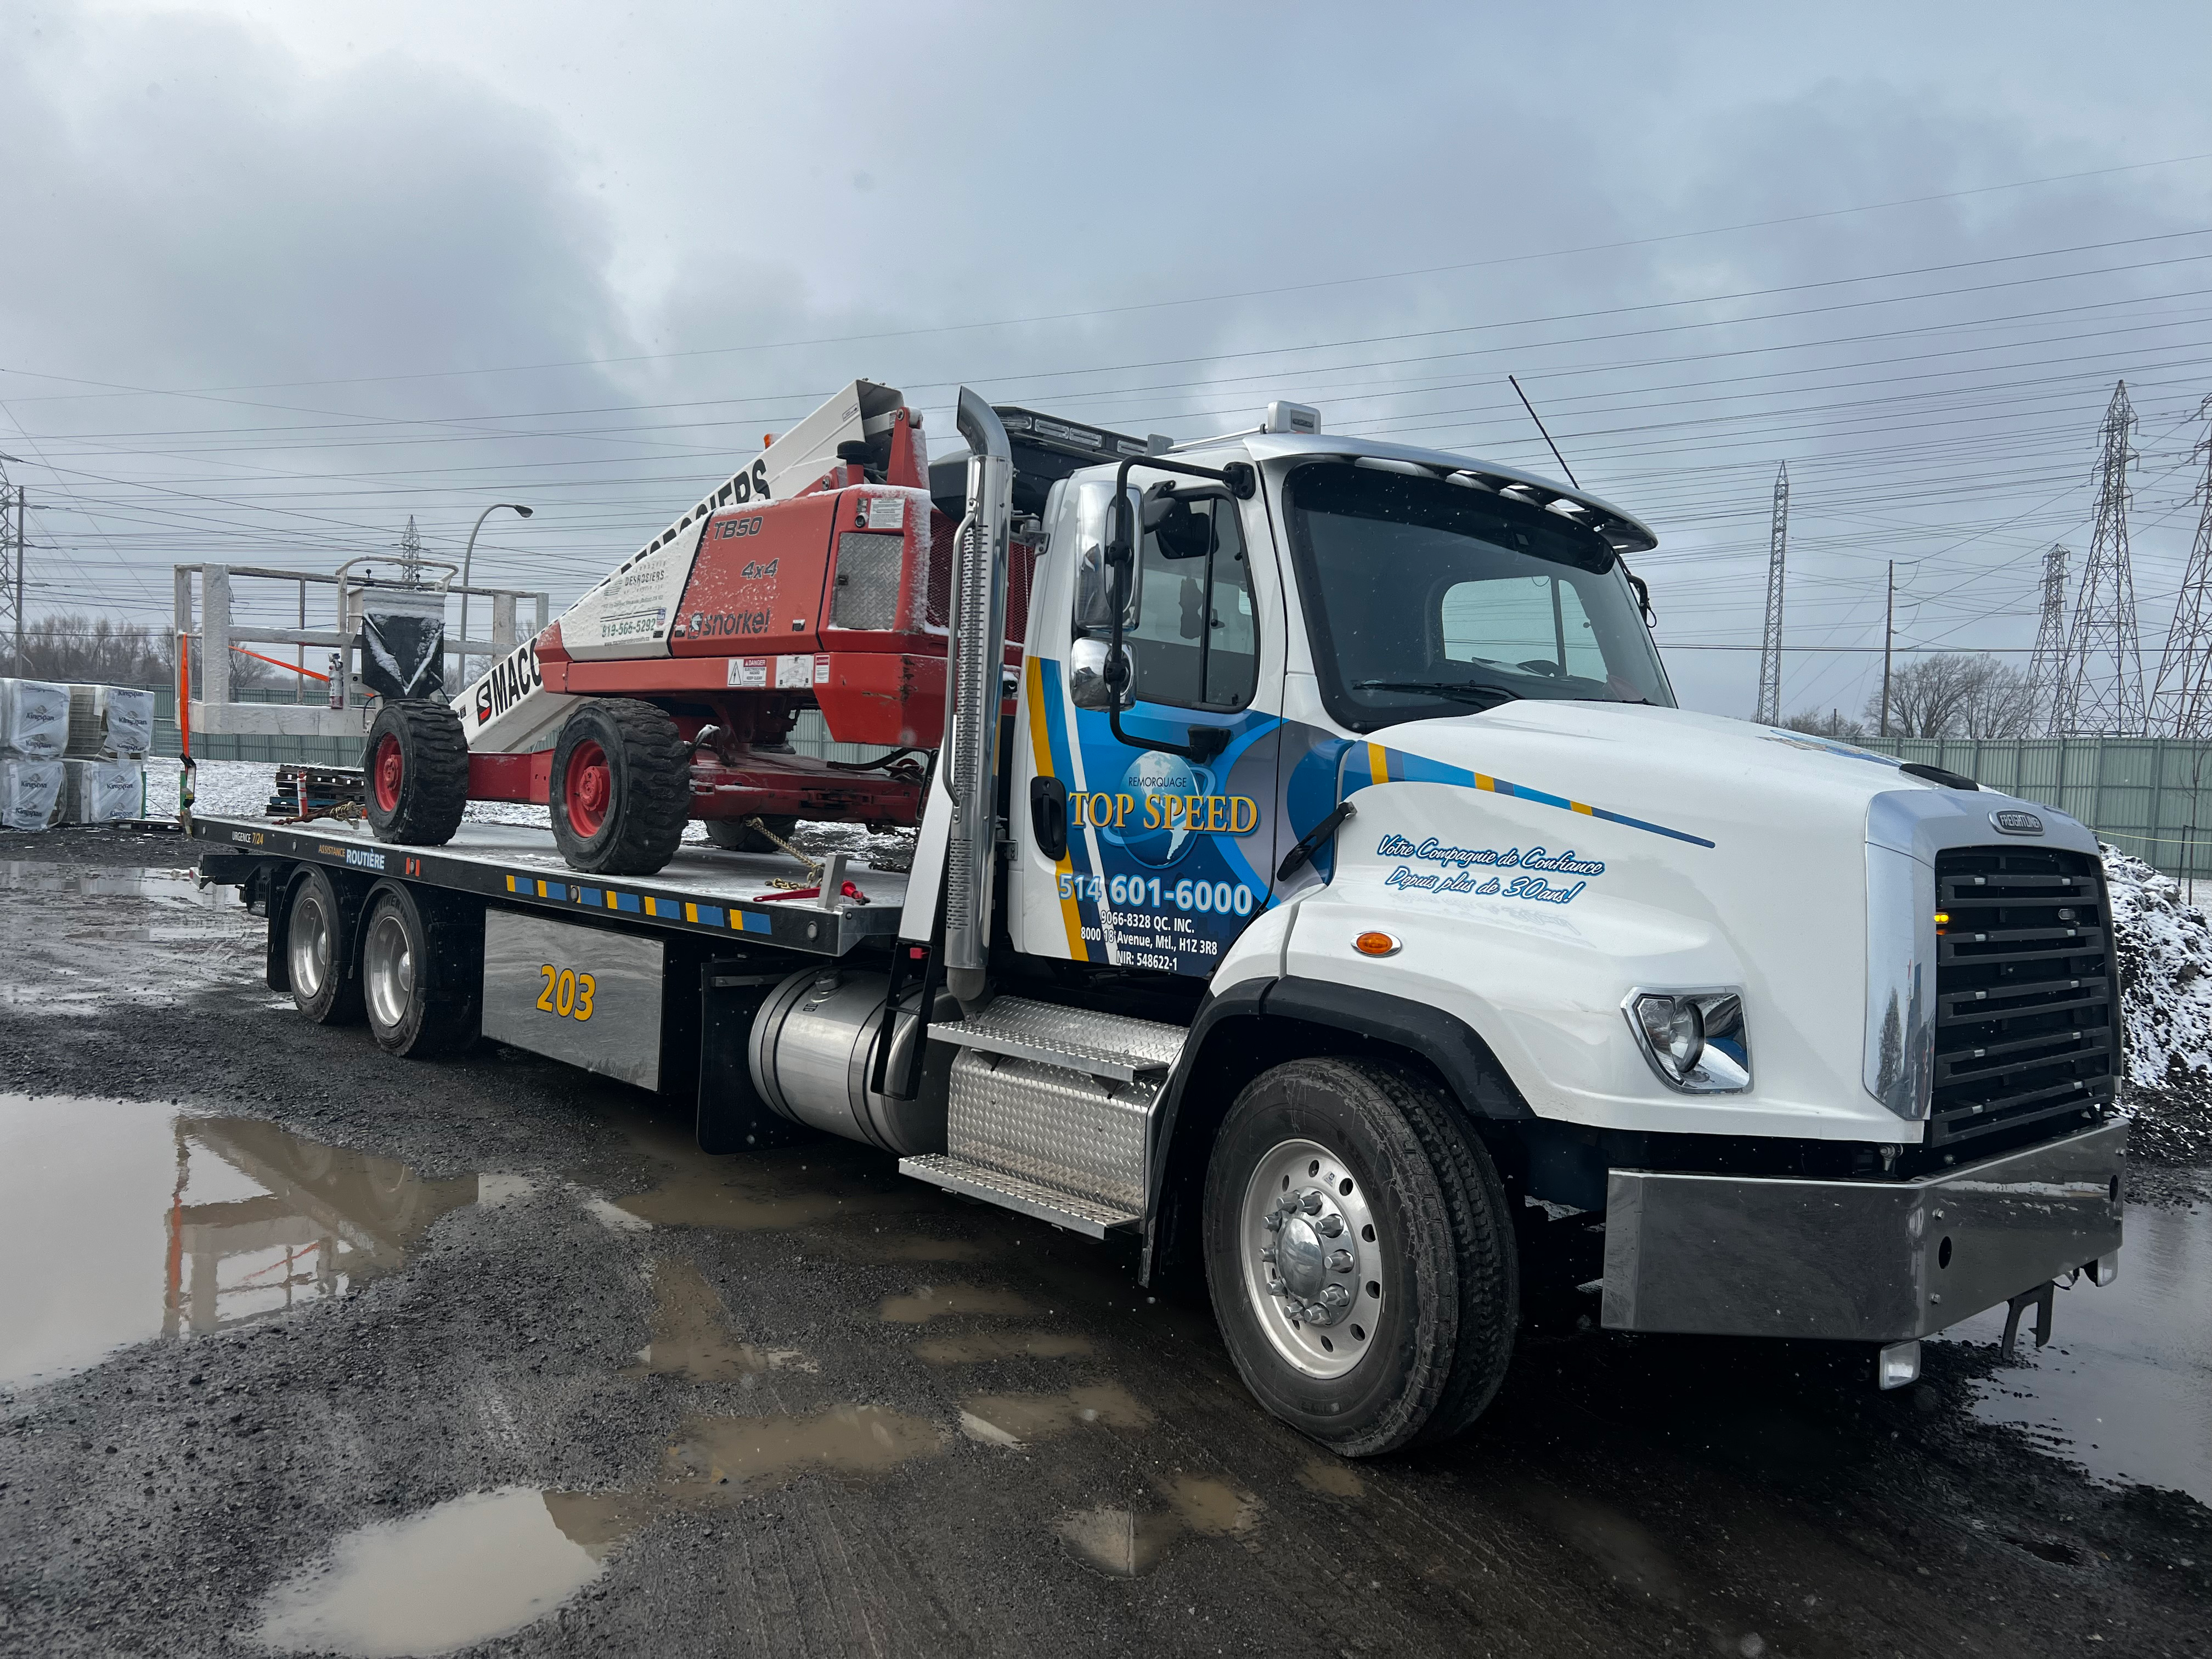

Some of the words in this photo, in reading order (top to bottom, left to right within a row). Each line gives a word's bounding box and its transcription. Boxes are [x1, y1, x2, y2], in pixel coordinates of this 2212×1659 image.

[714, 516, 763, 540] TB50
[624, 570, 664, 586] DESROSIERS
[741, 558, 780, 580] 4x4
[703, 608, 771, 636] snorkel
[118, 690, 144, 698] Kingspan
[26, 712, 54, 722] Kingspan
[1128, 776, 1187, 788] REMORQUAGE
[1069, 791, 1135, 828] TOP
[1143, 793, 1259, 833] SPEED
[1999, 814, 2041, 828] FREIGHTLINER
[232, 831, 251, 844] URGENCE
[251, 831, 264, 845] 7/24
[318, 844, 346, 858] ASSISTANCE
[346, 848, 385, 870] ROUTIÈRE
[1377, 834, 1415, 857] Votre
[1415, 836, 1497, 867] Compagnie
[1497, 847, 1519, 867] de
[1520, 847, 1606, 877] Confiance
[1385, 865, 1440, 890] Depuis
[1435, 871, 1475, 894] plus
[1475, 878, 1500, 895] de
[1059, 873, 1102, 902] 514
[1109, 874, 1253, 916] 601-6000
[1101, 910, 1151, 928] 9066-8328
[1154, 917, 1171, 932] QC.
[1174, 918, 1195, 934] INC.
[1080, 927, 1101, 942] 8000
[1117, 933, 1153, 950] Avenue,
[1179, 938, 1197, 953] H1Z
[1199, 940, 1218, 956] 3R8
[1116, 950, 1135, 966] NIR:
[1136, 951, 1178, 970] 548622-1
[535, 963, 596, 1022] 203
